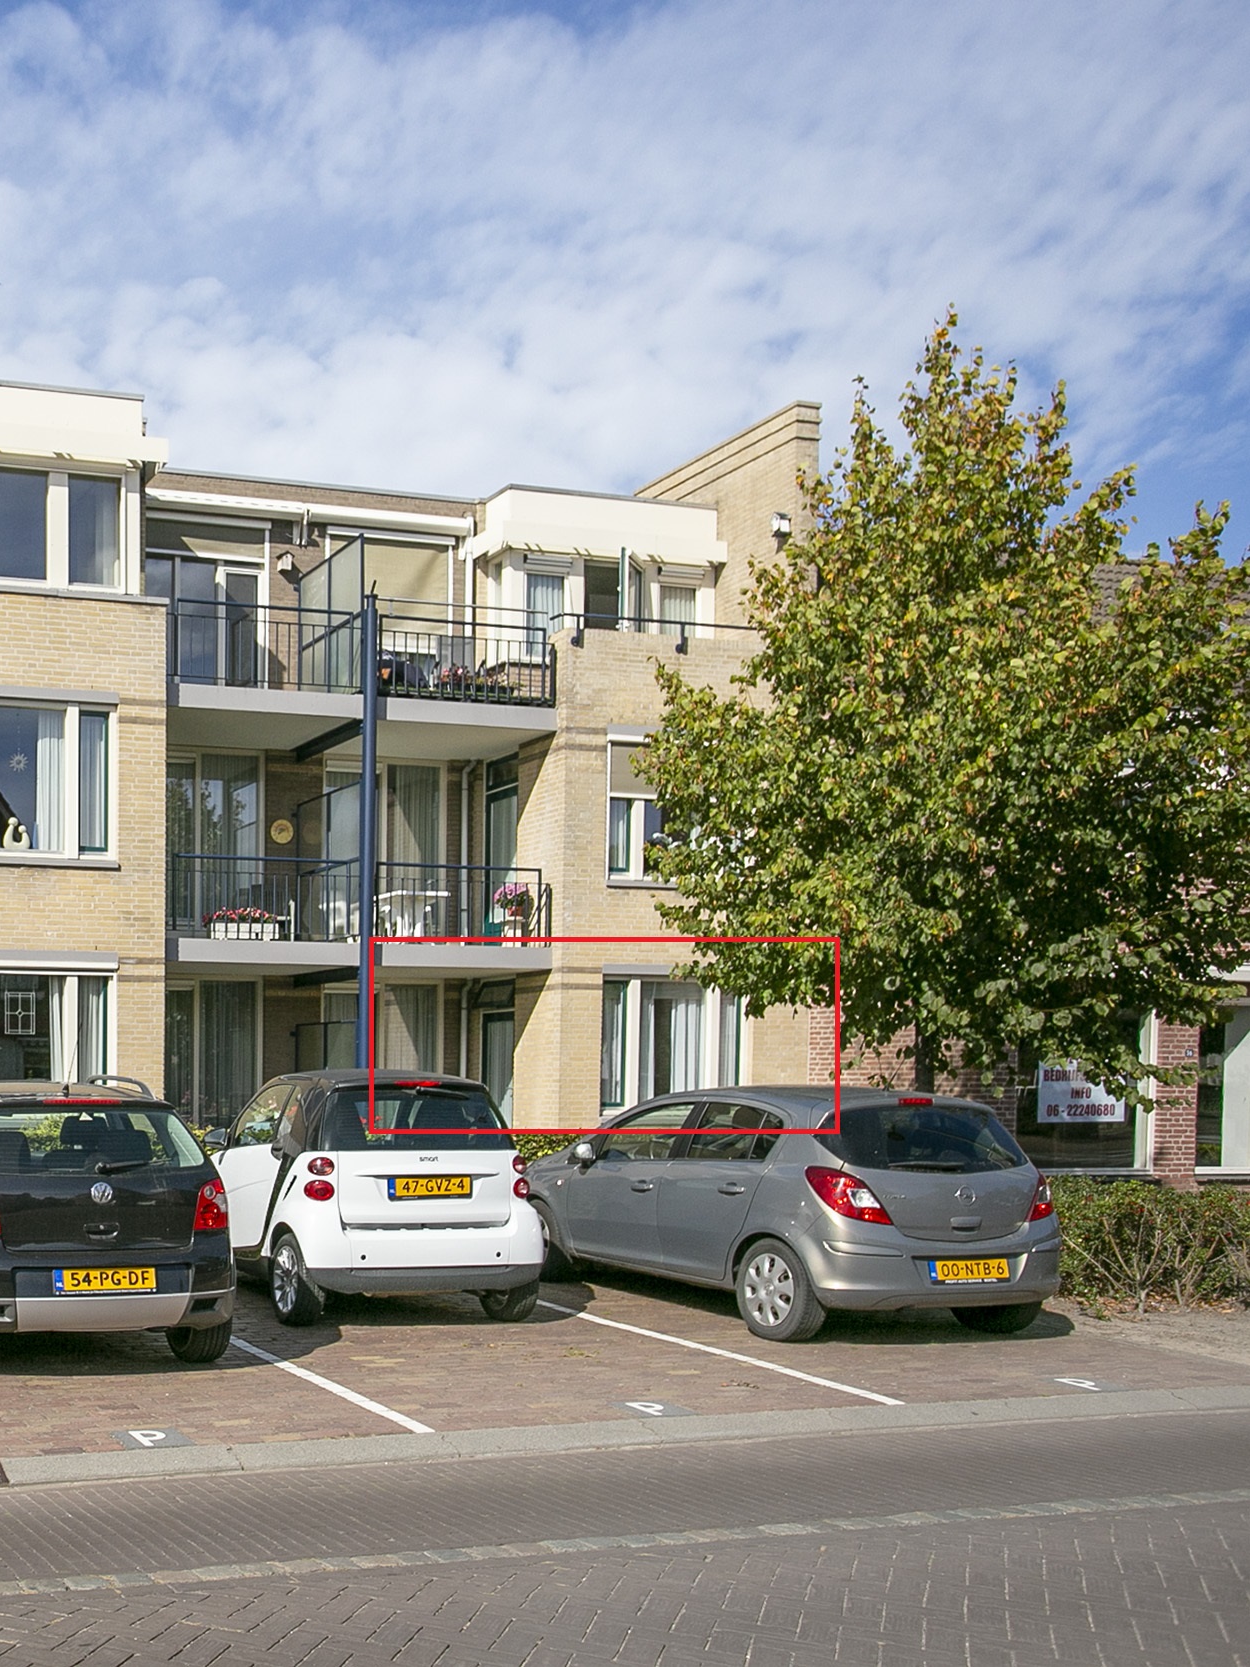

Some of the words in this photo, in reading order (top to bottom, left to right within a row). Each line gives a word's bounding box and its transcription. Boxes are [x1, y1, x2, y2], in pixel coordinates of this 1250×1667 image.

[1070, 1087, 1092, 1099] INFO
[402, 1179, 465, 1193] 47-GVZ-4
[941, 1262, 1005, 1277] 00-NTB-6
[70, 1270, 150, 1287] 54-PG-DF
[625, 1401, 664, 1416] P
[128, 1429, 167, 1447] P
